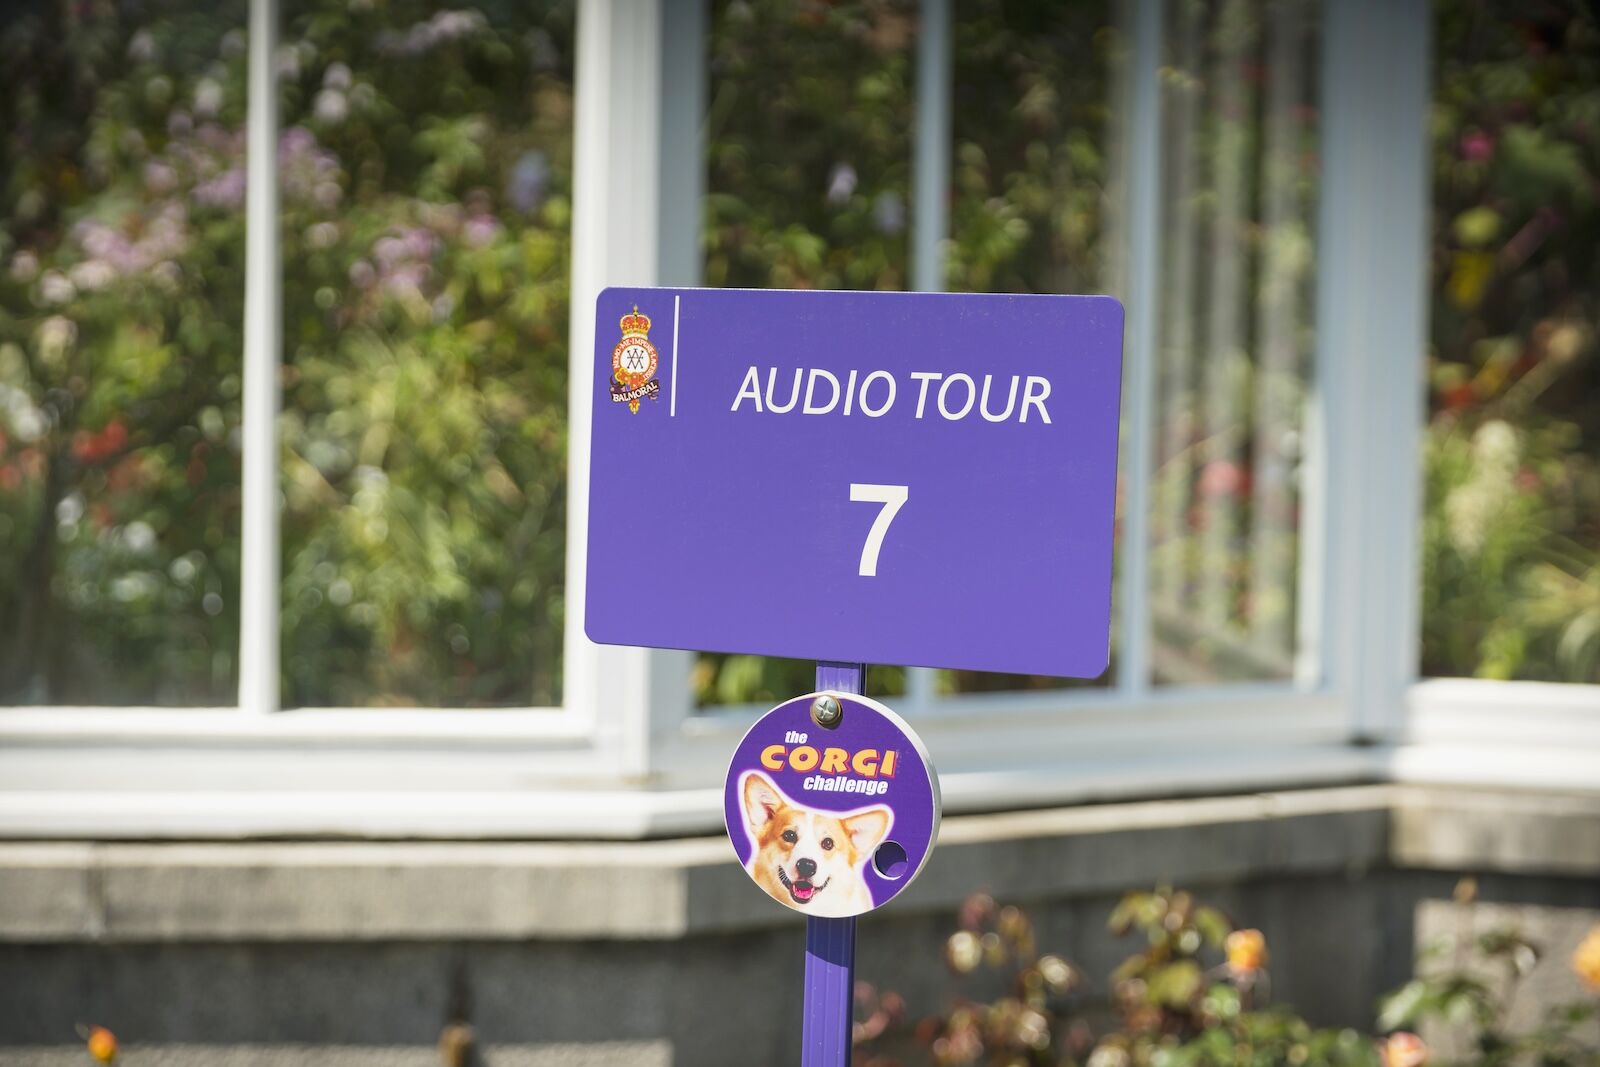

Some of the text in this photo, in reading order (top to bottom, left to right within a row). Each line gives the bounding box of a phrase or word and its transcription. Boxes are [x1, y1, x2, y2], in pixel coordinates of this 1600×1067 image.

[612, 381, 658, 403] BALMORAL
[731, 366, 1052, 424] AUDIO TOUR
[849, 483, 909, 577] 7
[785, 731, 808, 744] the
[760, 744, 897, 778] CORGI
[803, 775, 888, 796] challenge
